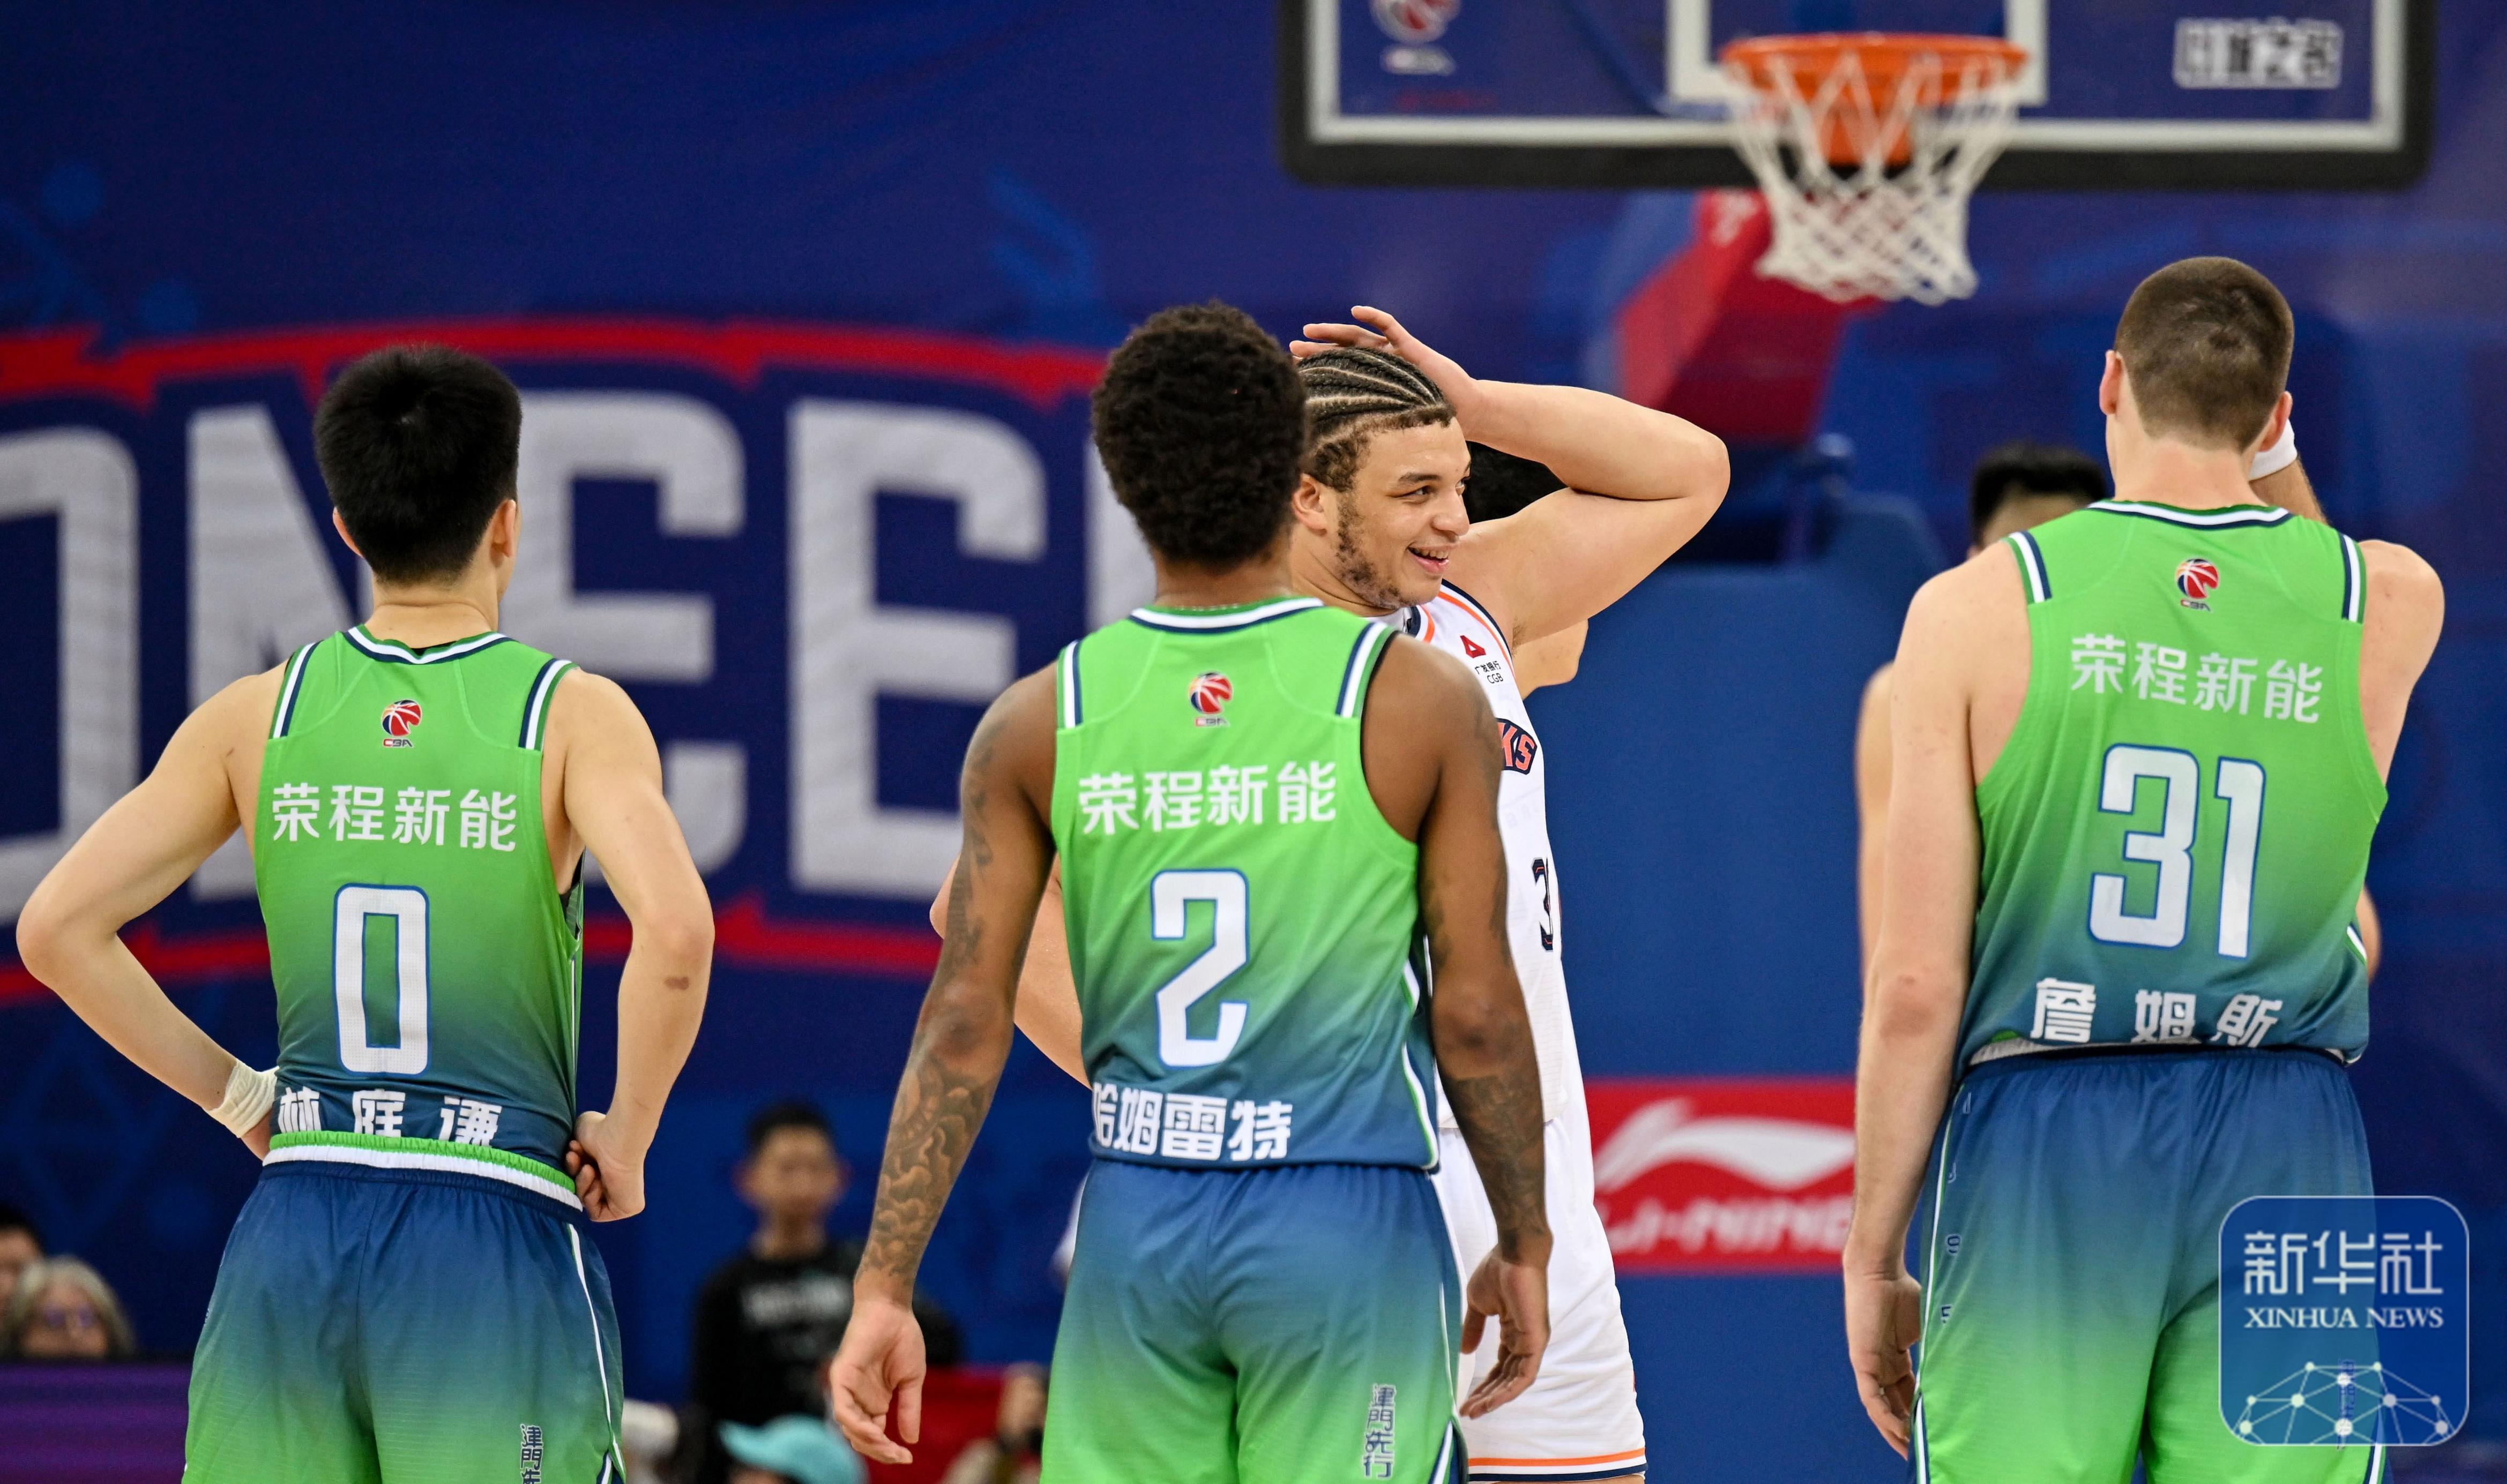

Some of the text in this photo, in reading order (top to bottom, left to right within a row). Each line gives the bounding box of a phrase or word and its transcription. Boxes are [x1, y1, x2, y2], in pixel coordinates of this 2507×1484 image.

[1474, 661, 1501, 675] 广发银行
[1487, 673, 1503, 684] CGB
[2071, 633, 2323, 723] 荣程新能
[382, 738, 413, 748] CBA
[272, 782, 517, 852] 荣程新能
[1078, 761, 1337, 835] 荣程新能
[2088, 741, 2266, 960] 31
[332, 882, 430, 1077] 0
[1150, 867, 1250, 1069] 2
[2030, 977, 2282, 1048] 詹姆斯
[1092, 1082, 1293, 1161] 哈姆雷特
